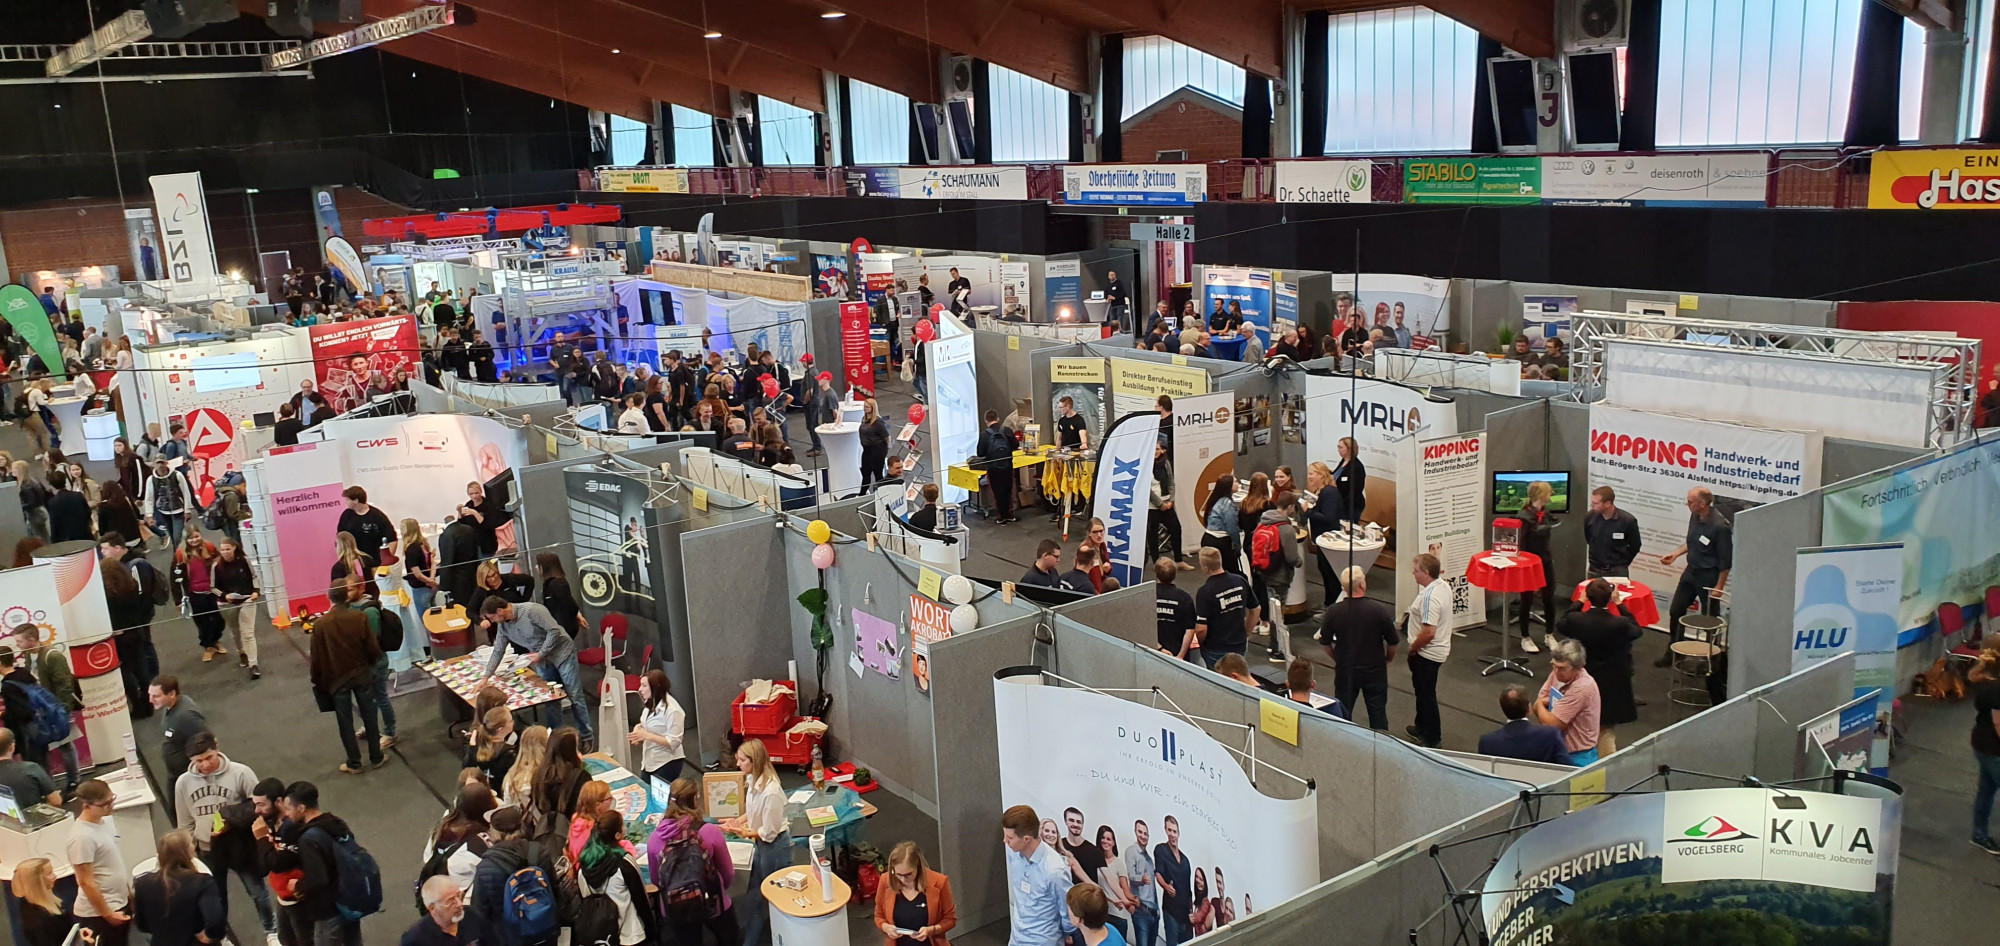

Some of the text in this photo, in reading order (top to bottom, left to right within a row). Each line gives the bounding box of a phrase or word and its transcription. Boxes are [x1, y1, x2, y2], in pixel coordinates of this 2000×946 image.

[1084, 119, 1094, 144] H
[632, 172, 650, 184] DROTT
[1143, 170, 1176, 188] Zeitung
[1409, 162, 1476, 182] STABILO
[1651, 169, 1704, 179] deisenroth
[1714, 169, 1720, 178] &
[942, 174, 1000, 188] SCHAUMANN
[1280, 186, 1350, 202] Dr. Schaette
[1156, 226, 1190, 239] Halle 2
[554, 266, 578, 275] KRAUSE
[324, 332, 345, 341] WILLST
[1122, 371, 1193, 389] Direkter Berufseinstieg
[1122, 381, 1155, 394] Ausbildung
[1178, 412, 1213, 427] MRH
[1341, 399, 1405, 434] MRH
[357, 438, 398, 448] CWS
[1424, 438, 1479, 460] KIPPING
[1591, 429, 1698, 469] KIPPING
[1424, 456, 1464, 468] Handwerk-
[1424, 459, 1478, 475] Industriebedarf
[1705, 447, 1800, 471] Handwerk- und
[1660, 468, 1685, 479] 36304
[1687, 473, 1716, 485] Alsfeld
[1704, 461, 1800, 486] Industriebedarf
[599, 483, 621, 492] EDAG
[276, 491, 319, 504] Herzlich
[278, 499, 340, 516] willkommen
[1107, 456, 1140, 562] KAMAX
[1445, 528, 1470, 537] Buildings
[910, 596, 951, 634] WORT
[1794, 627, 1847, 650] HLU
[1118, 726, 1223, 786] DUO PLAST
[1091, 770, 1110, 782] DU
[1114, 774, 1135, 786] und
[1140, 780, 1163, 797] WIR
[1677, 845, 1744, 856] VOGELSBERG
[1769, 848, 1874, 866] Kommunales Jobcenter
[1514, 841, 1644, 909] PERSPEKTIVEN
